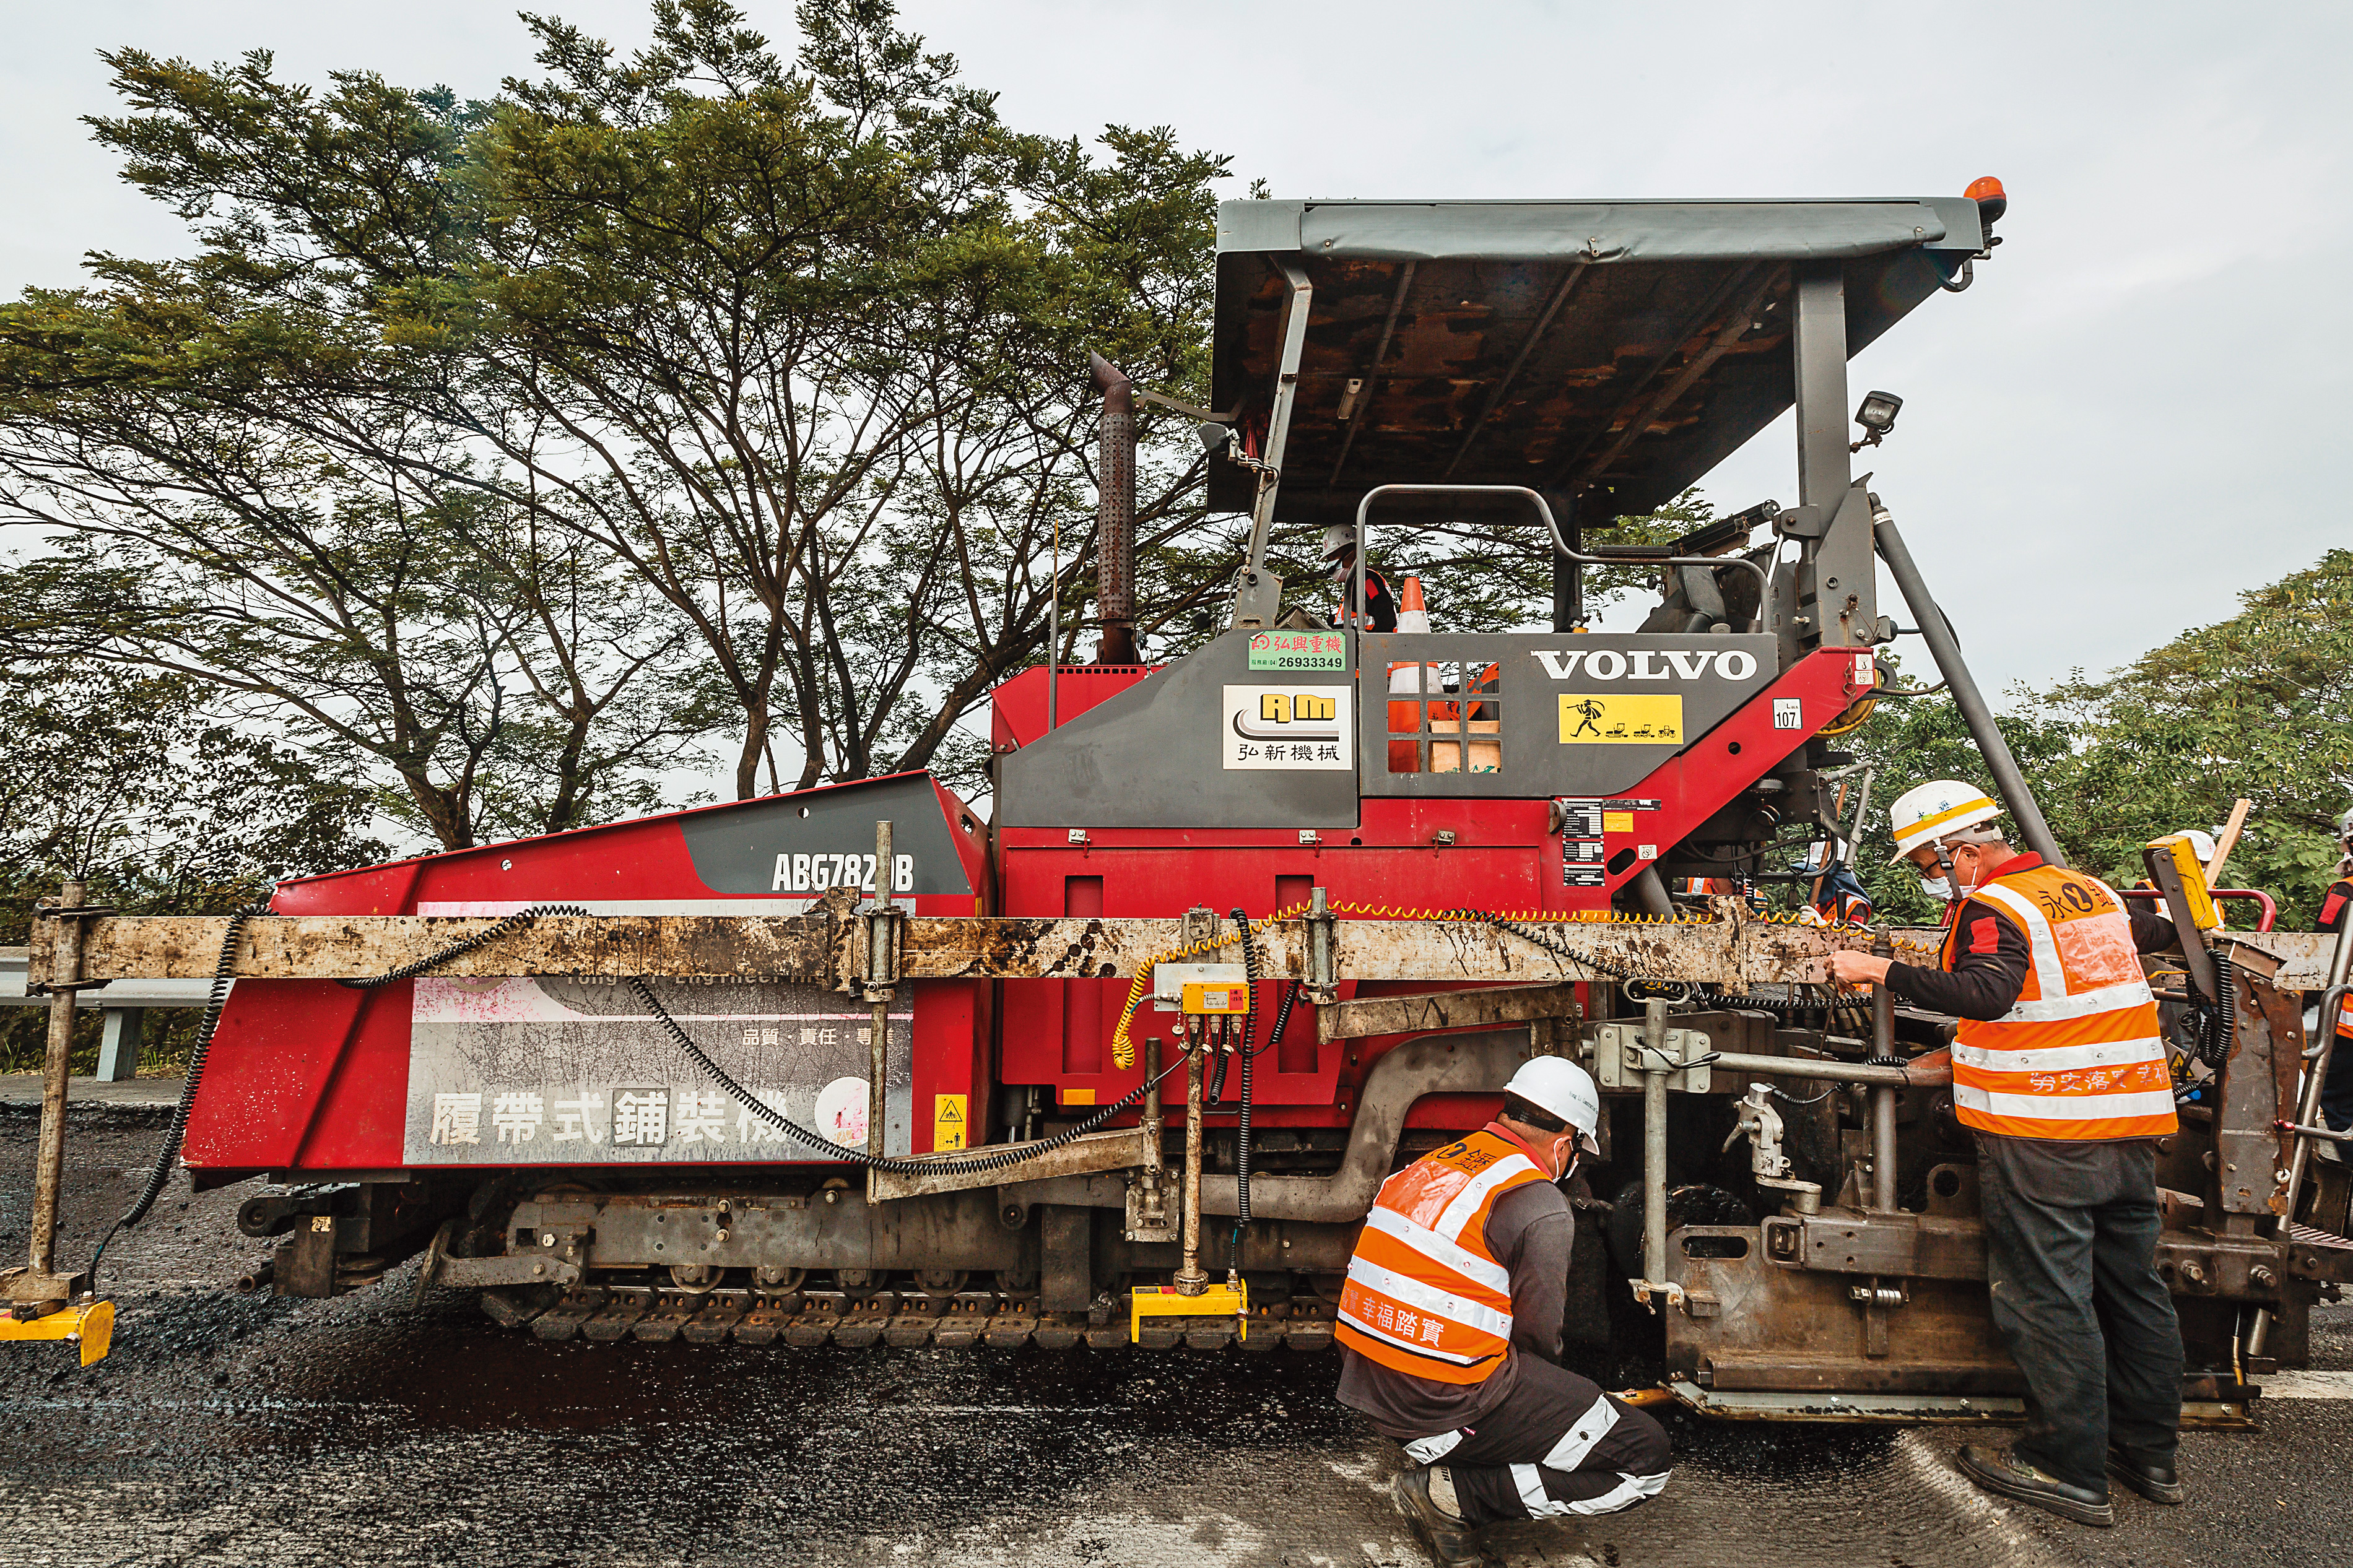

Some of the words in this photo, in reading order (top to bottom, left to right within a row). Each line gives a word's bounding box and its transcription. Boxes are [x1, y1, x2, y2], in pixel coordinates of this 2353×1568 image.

[1274, 636, 1342, 654] 弘興重機
[1279, 657, 1342, 667] 26933349
[1530, 650, 1757, 680] VOLVO
[1777, 712, 1796, 727] 107
[1238, 744, 1340, 761] 弘新機械
[772, 854, 913, 891] ABG782B
[1362, 1296, 1444, 1348] 幸福踏實
